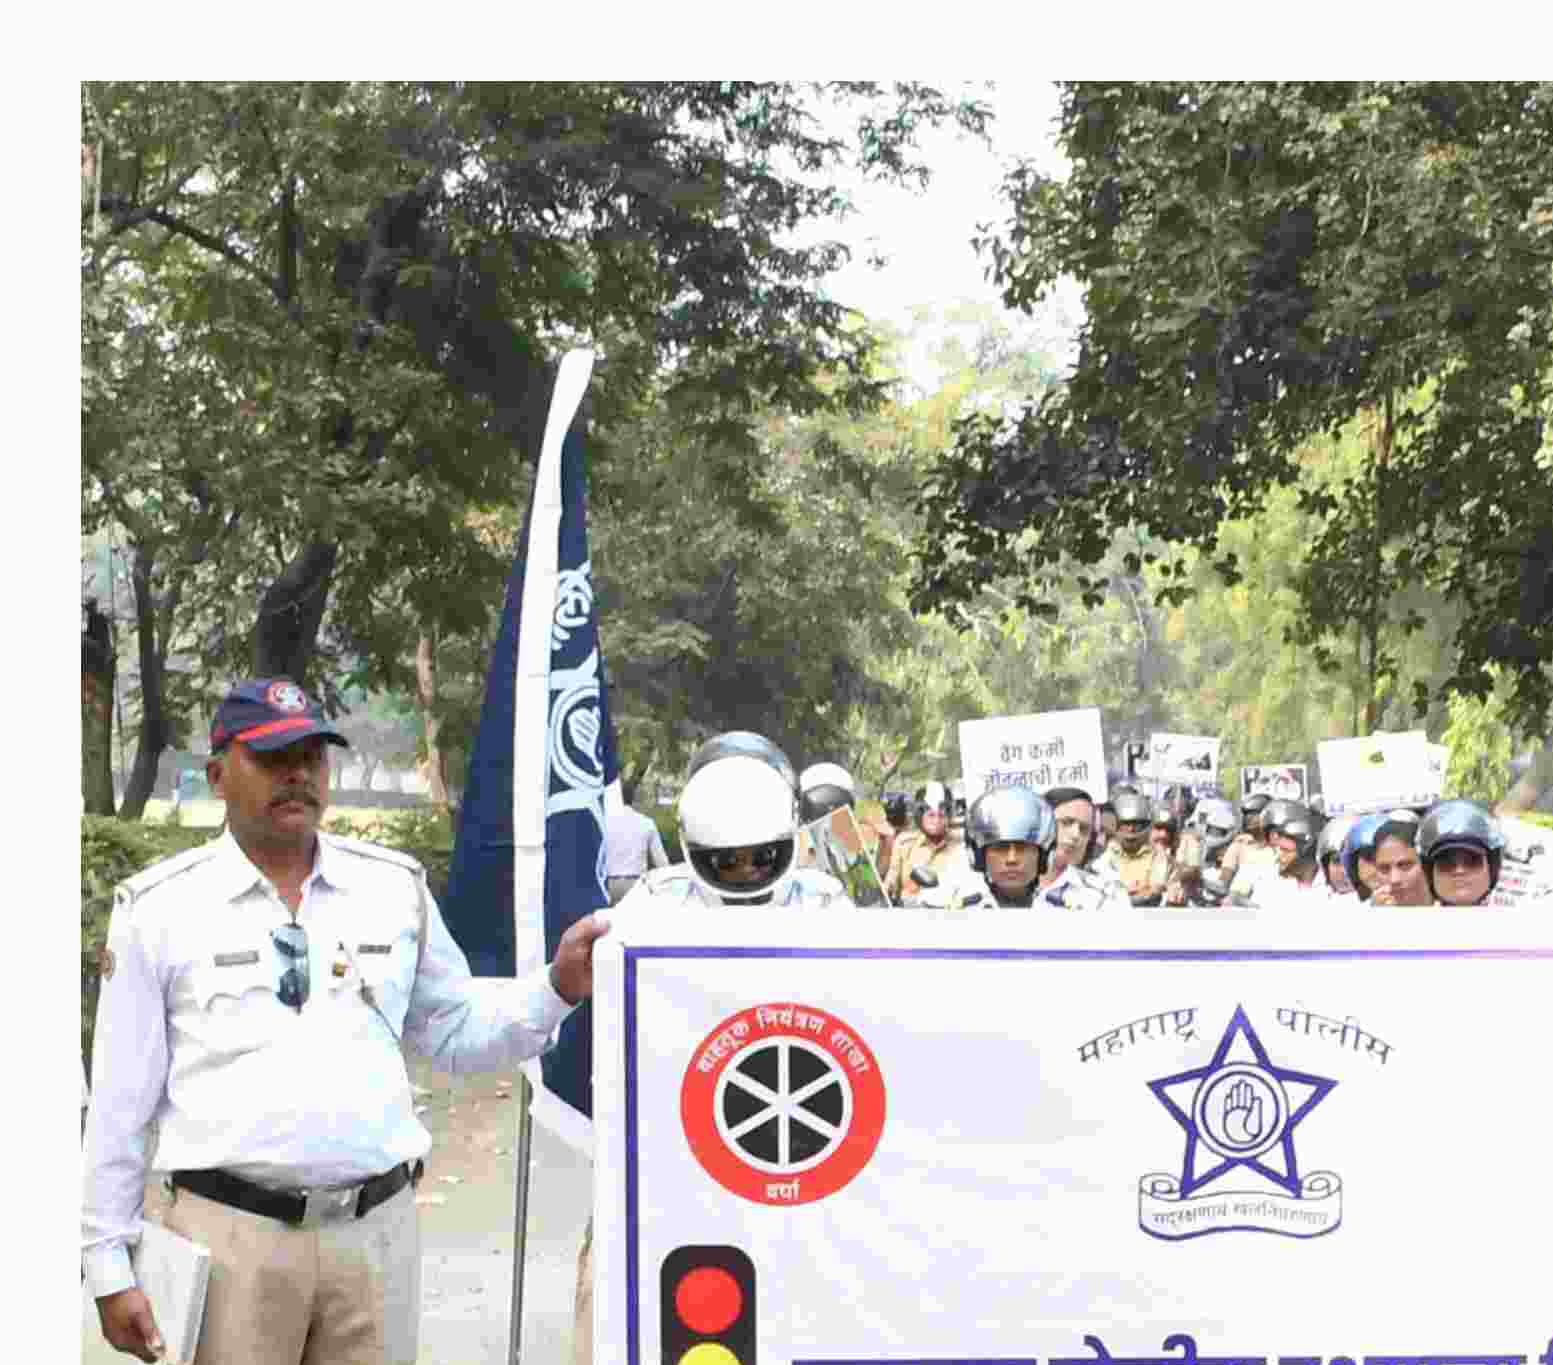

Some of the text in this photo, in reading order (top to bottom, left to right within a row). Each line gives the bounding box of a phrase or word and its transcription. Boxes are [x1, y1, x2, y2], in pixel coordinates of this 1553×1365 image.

[697, 1007, 870, 1074] वाहतूक नियंत्रण शाखा
[1077, 1000, 1396, 1064] महाराष्ट्र पोलीस
[767, 1177, 801, 1199] वर्धा
